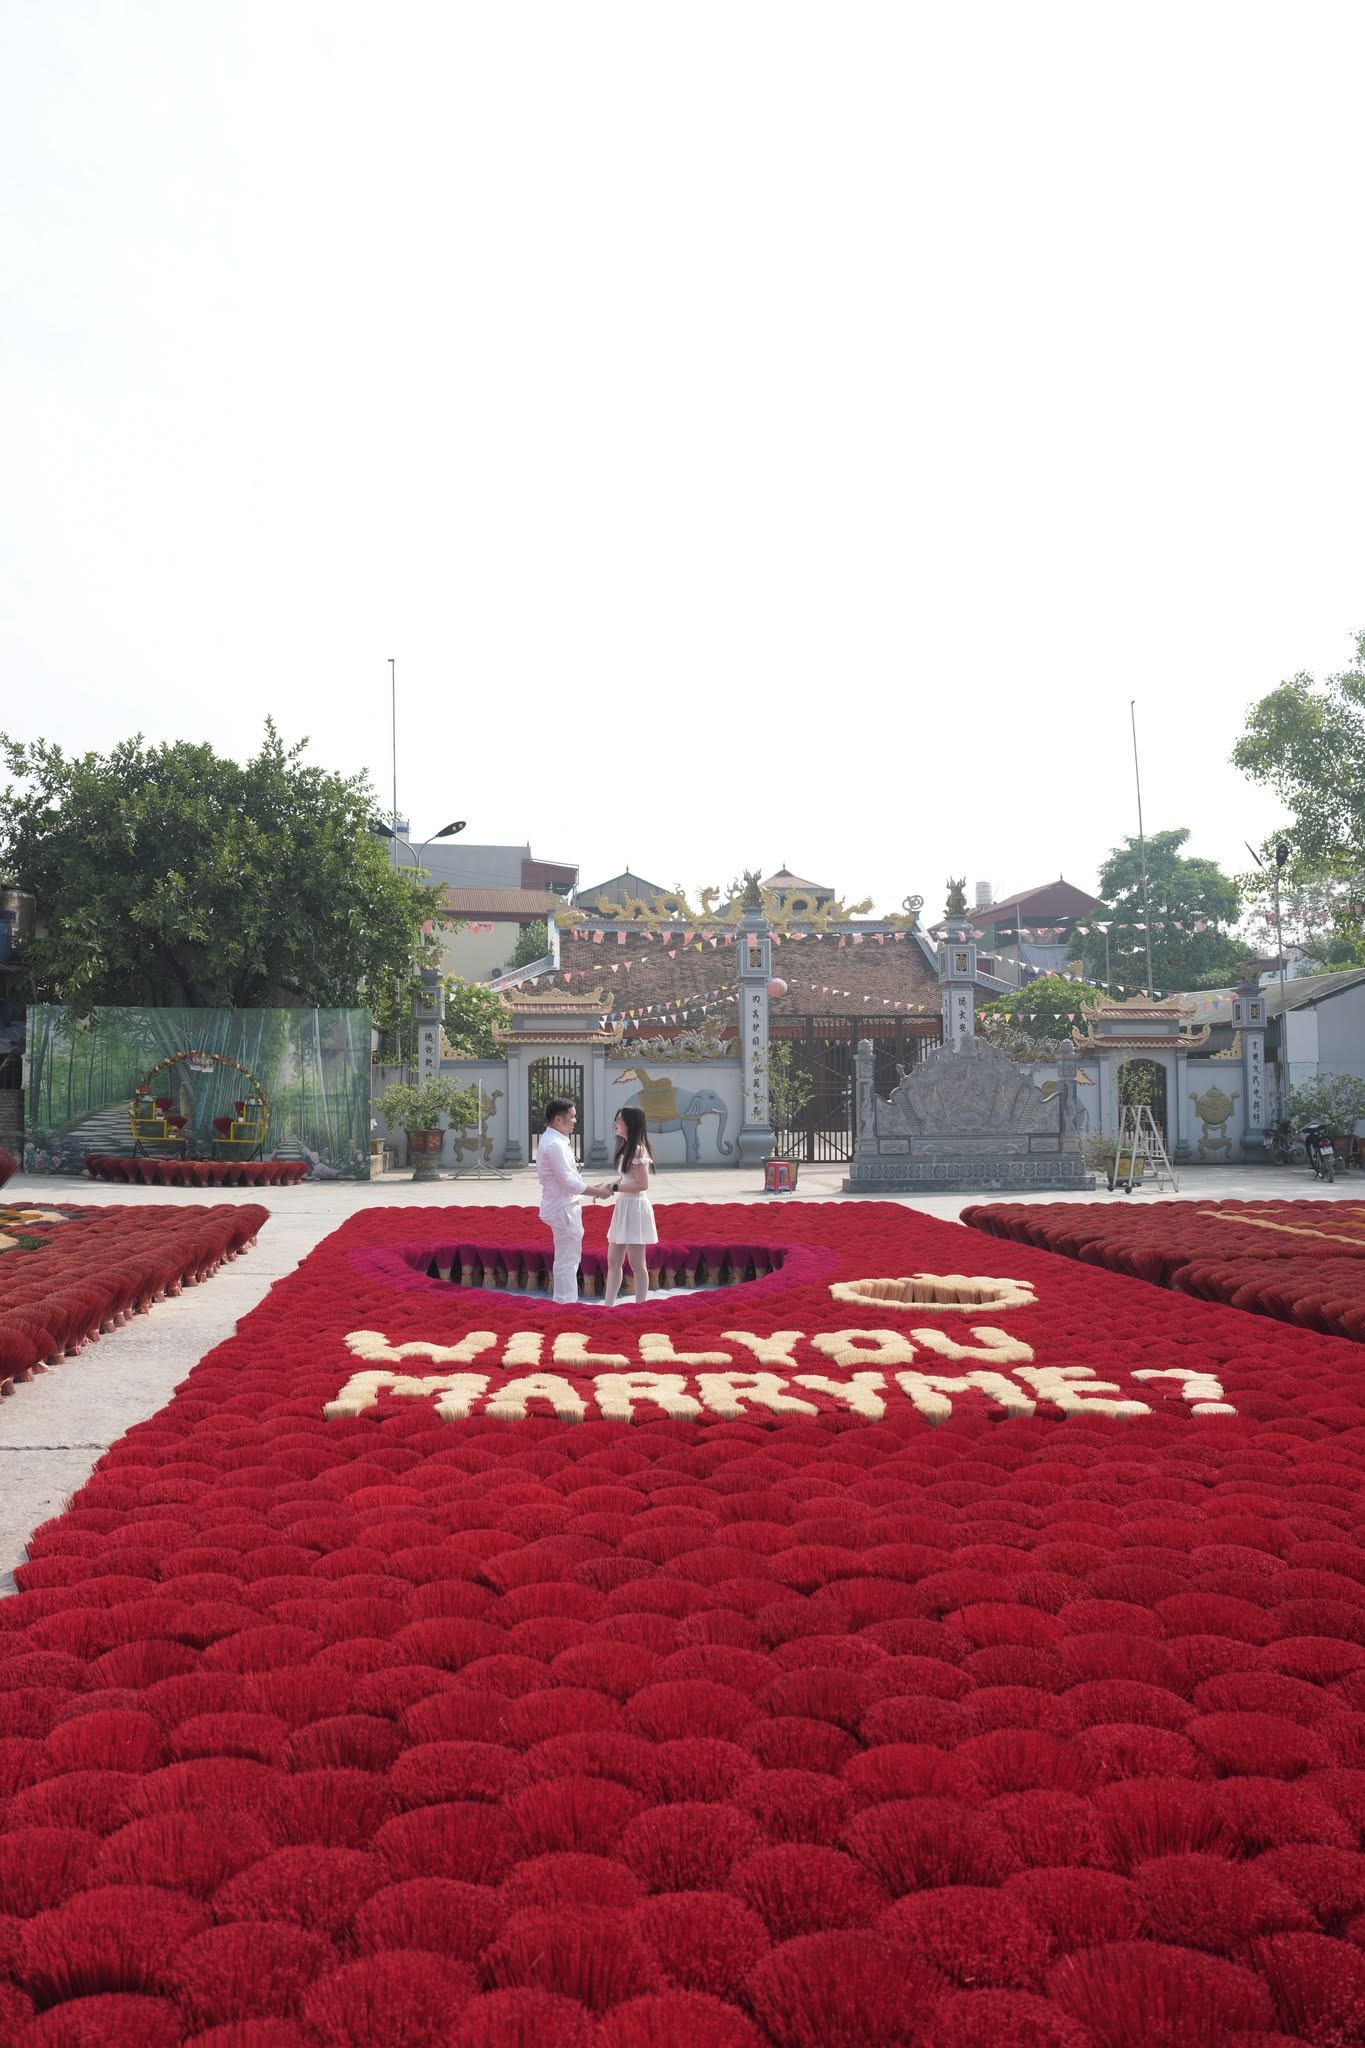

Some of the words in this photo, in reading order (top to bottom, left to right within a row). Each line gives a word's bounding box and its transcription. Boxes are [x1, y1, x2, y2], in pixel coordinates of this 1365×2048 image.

[343, 1330, 731, 1368] WILL
[720, 1326, 1035, 1368] YOU
[323, 1369, 890, 1425] MARRY
